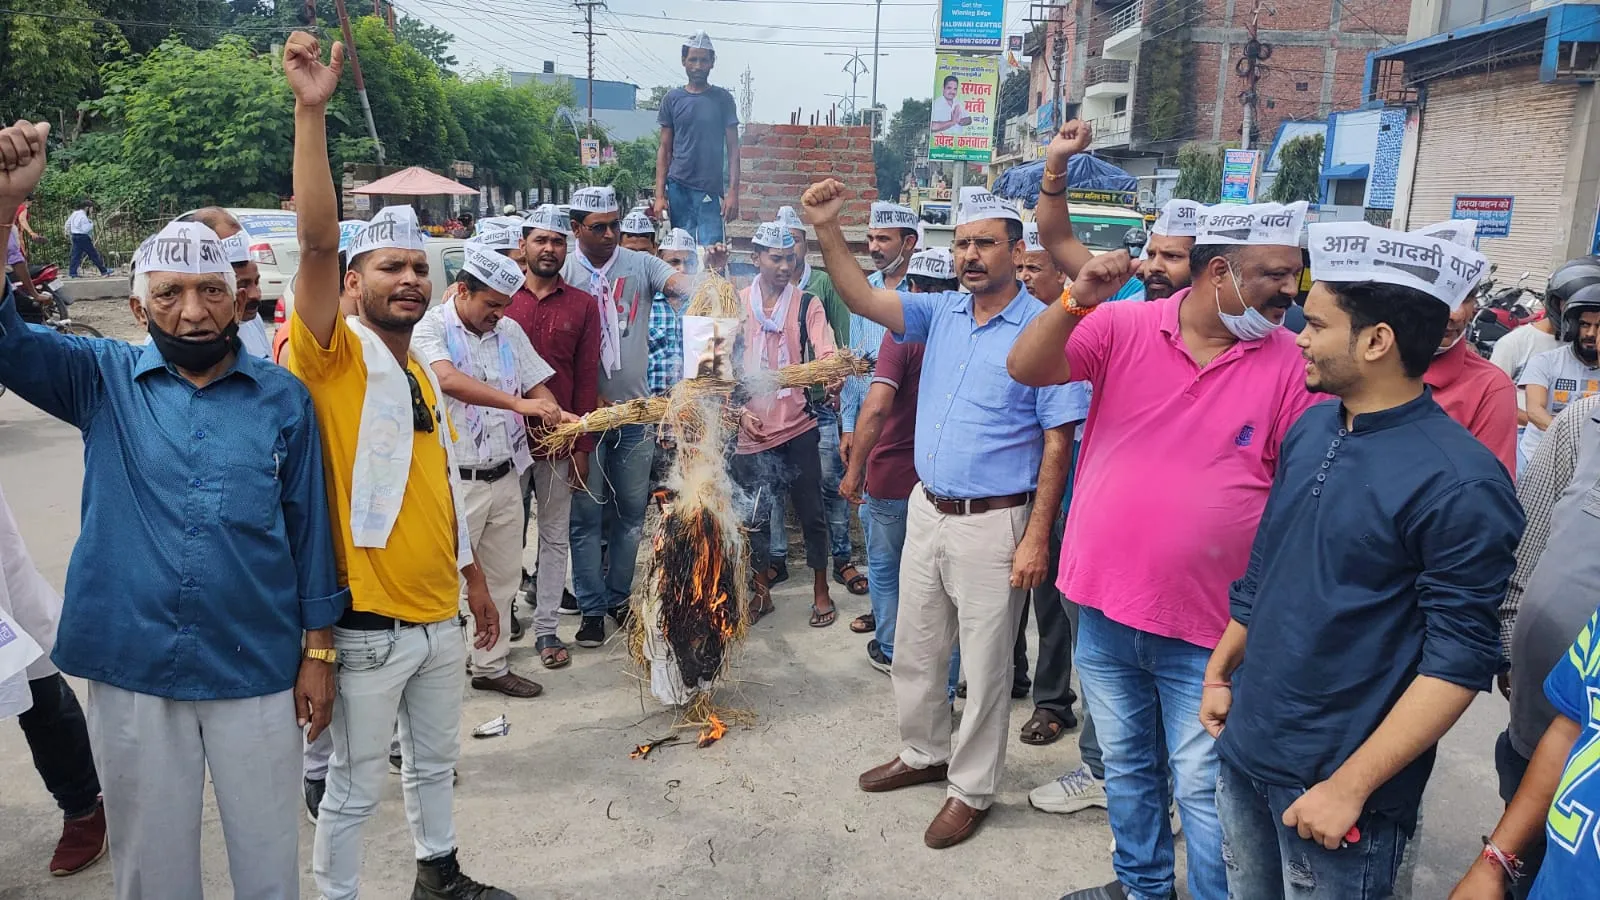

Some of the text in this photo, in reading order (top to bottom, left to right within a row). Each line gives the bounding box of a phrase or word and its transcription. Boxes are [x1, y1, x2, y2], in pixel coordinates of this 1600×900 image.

[961, 80, 993, 96] संगठन
[937, 190, 952, 199] KG
[970, 193, 996, 203] आम
[1457, 199, 1477, 210] कृपया
[1498, 198, 1509, 209] को
[876, 210, 893, 224] आम
[1210, 215, 1256, 227] आदमी
[1260, 209, 1296, 227] पार्टी
[368, 212, 397, 244] पार्टी
[485, 230, 510, 241] आदमी
[157, 227, 192, 266] पार्टी
[472, 251, 500, 273] आदमी
[1323, 236, 1485, 284] आम आदमी पार्टी
